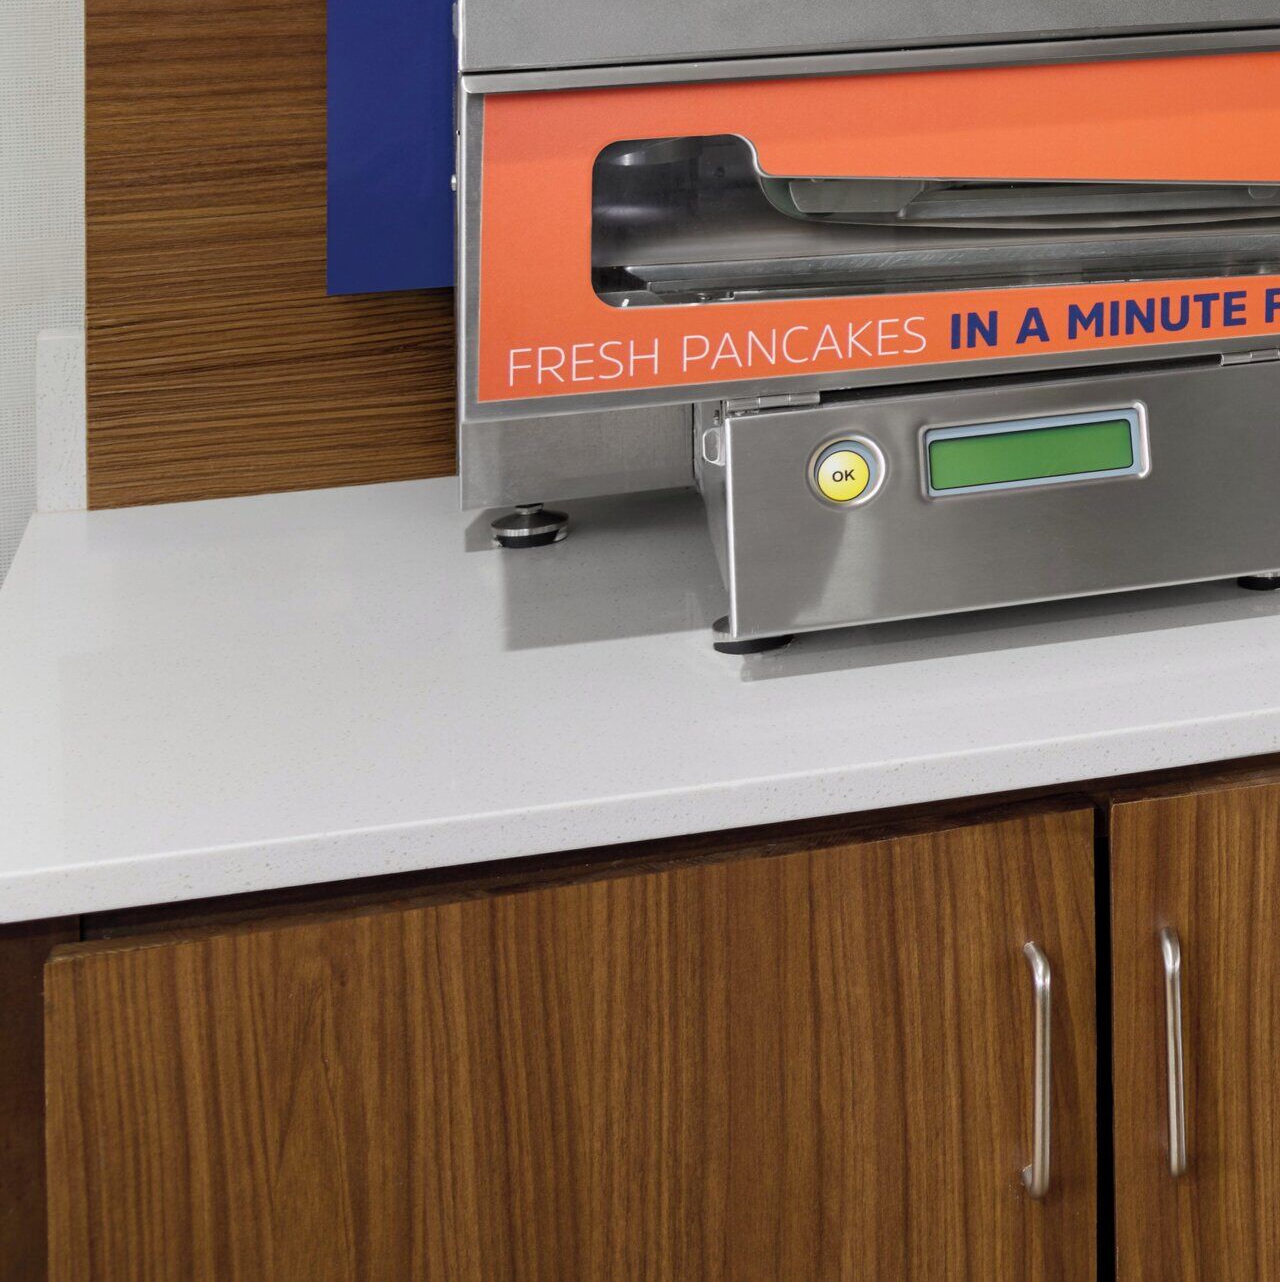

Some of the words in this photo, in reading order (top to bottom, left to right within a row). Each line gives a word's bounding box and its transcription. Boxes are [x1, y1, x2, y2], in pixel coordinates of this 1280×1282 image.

[507, 337, 660, 388] FRESH
[681, 315, 928, 373] PANCAKES
[950, 310, 999, 350] IN
[1016, 307, 1050, 345] A
[1067, 290, 1248, 341] MINUTE
[831, 469, 856, 484] OK
